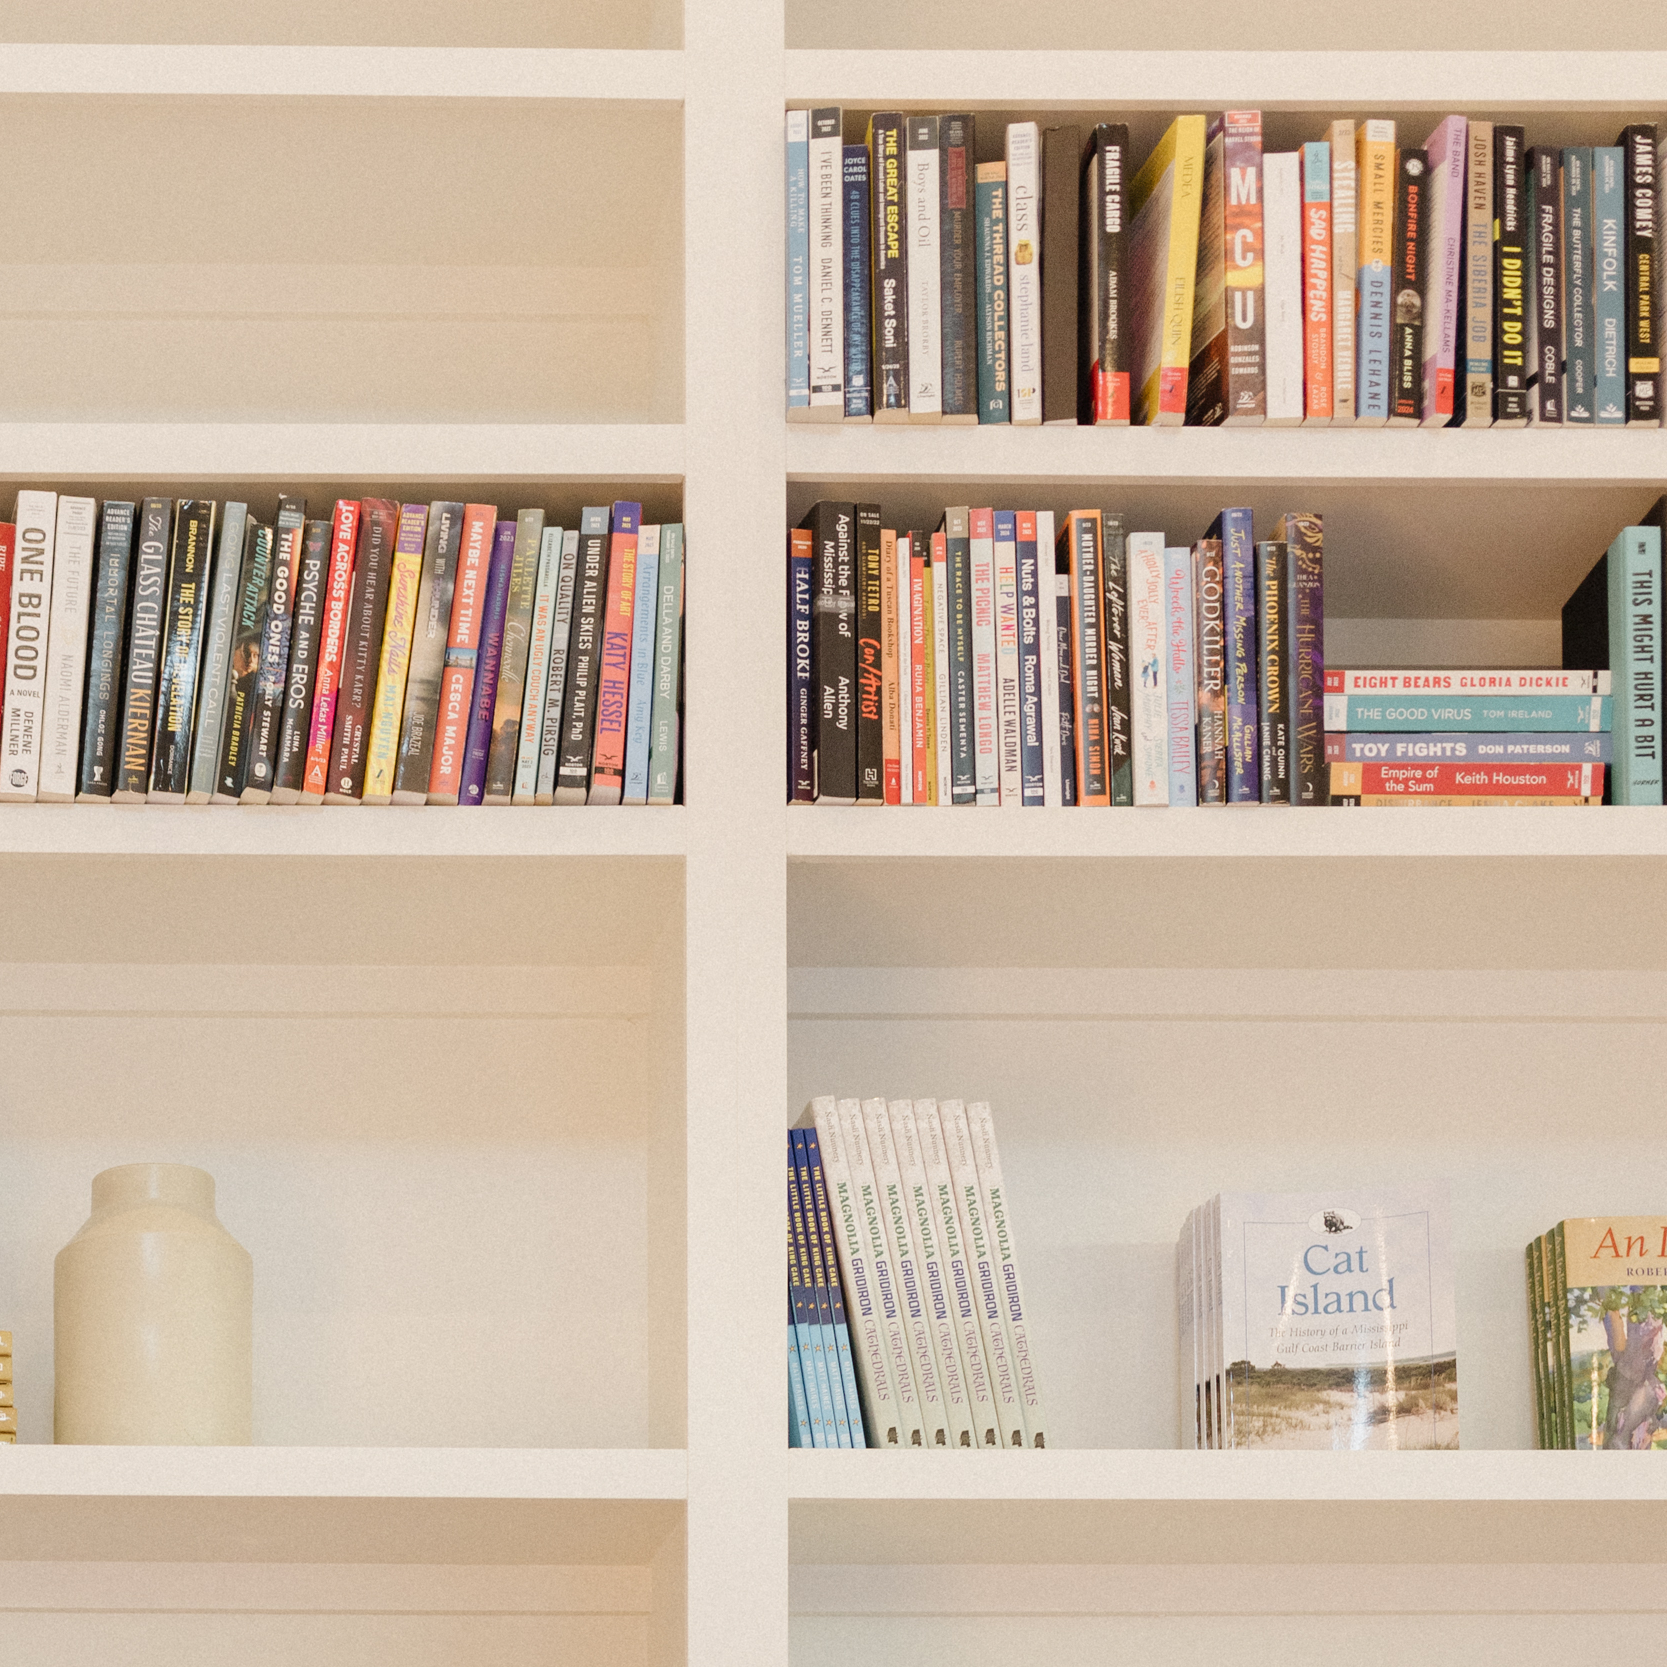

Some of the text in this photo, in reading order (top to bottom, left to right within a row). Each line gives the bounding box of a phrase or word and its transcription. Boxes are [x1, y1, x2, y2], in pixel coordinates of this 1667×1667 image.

[885, 128, 899, 258] THE GREAT ESCAPE
[1106, 146, 1121, 233] FRAGILE CARGO
[1634, 135, 1652, 238] JAMES COMEY
[1310, 208, 1327, 322] SAD HAPPENS
[1603, 219, 1617, 292] KINFOLK
[14, 527, 46, 681] ONE BLOOD
[457, 521, 484, 644] MAYBE NEXT TIME
[1632, 570, 1653, 608] THIS
[1202, 566, 1221, 692] GODKILLER
[1632, 613, 1654, 663] MIGHT
[17, 689, 40, 697] NOVEL
[600, 631, 628, 734] KATY HESSEL
[1354, 676, 1451, 689] EIGHT BEARS
[1633, 671, 1654, 712] HURT
[1352, 743, 1467, 757] TOY FIGHTS
[1634, 731, 1655, 760] BIT
[1380, 766, 1438, 778] Empire of
[1385, 780, 1434, 791] the Sum
[990, 1187, 1011, 1262] MAGNOLIA
[1002, 1263, 1023, 1321] GRIDIRON
[1303, 1245, 1369, 1276] Cat
[1590, 1227, 1648, 1259] An
[1277, 1278, 1396, 1316] Island
